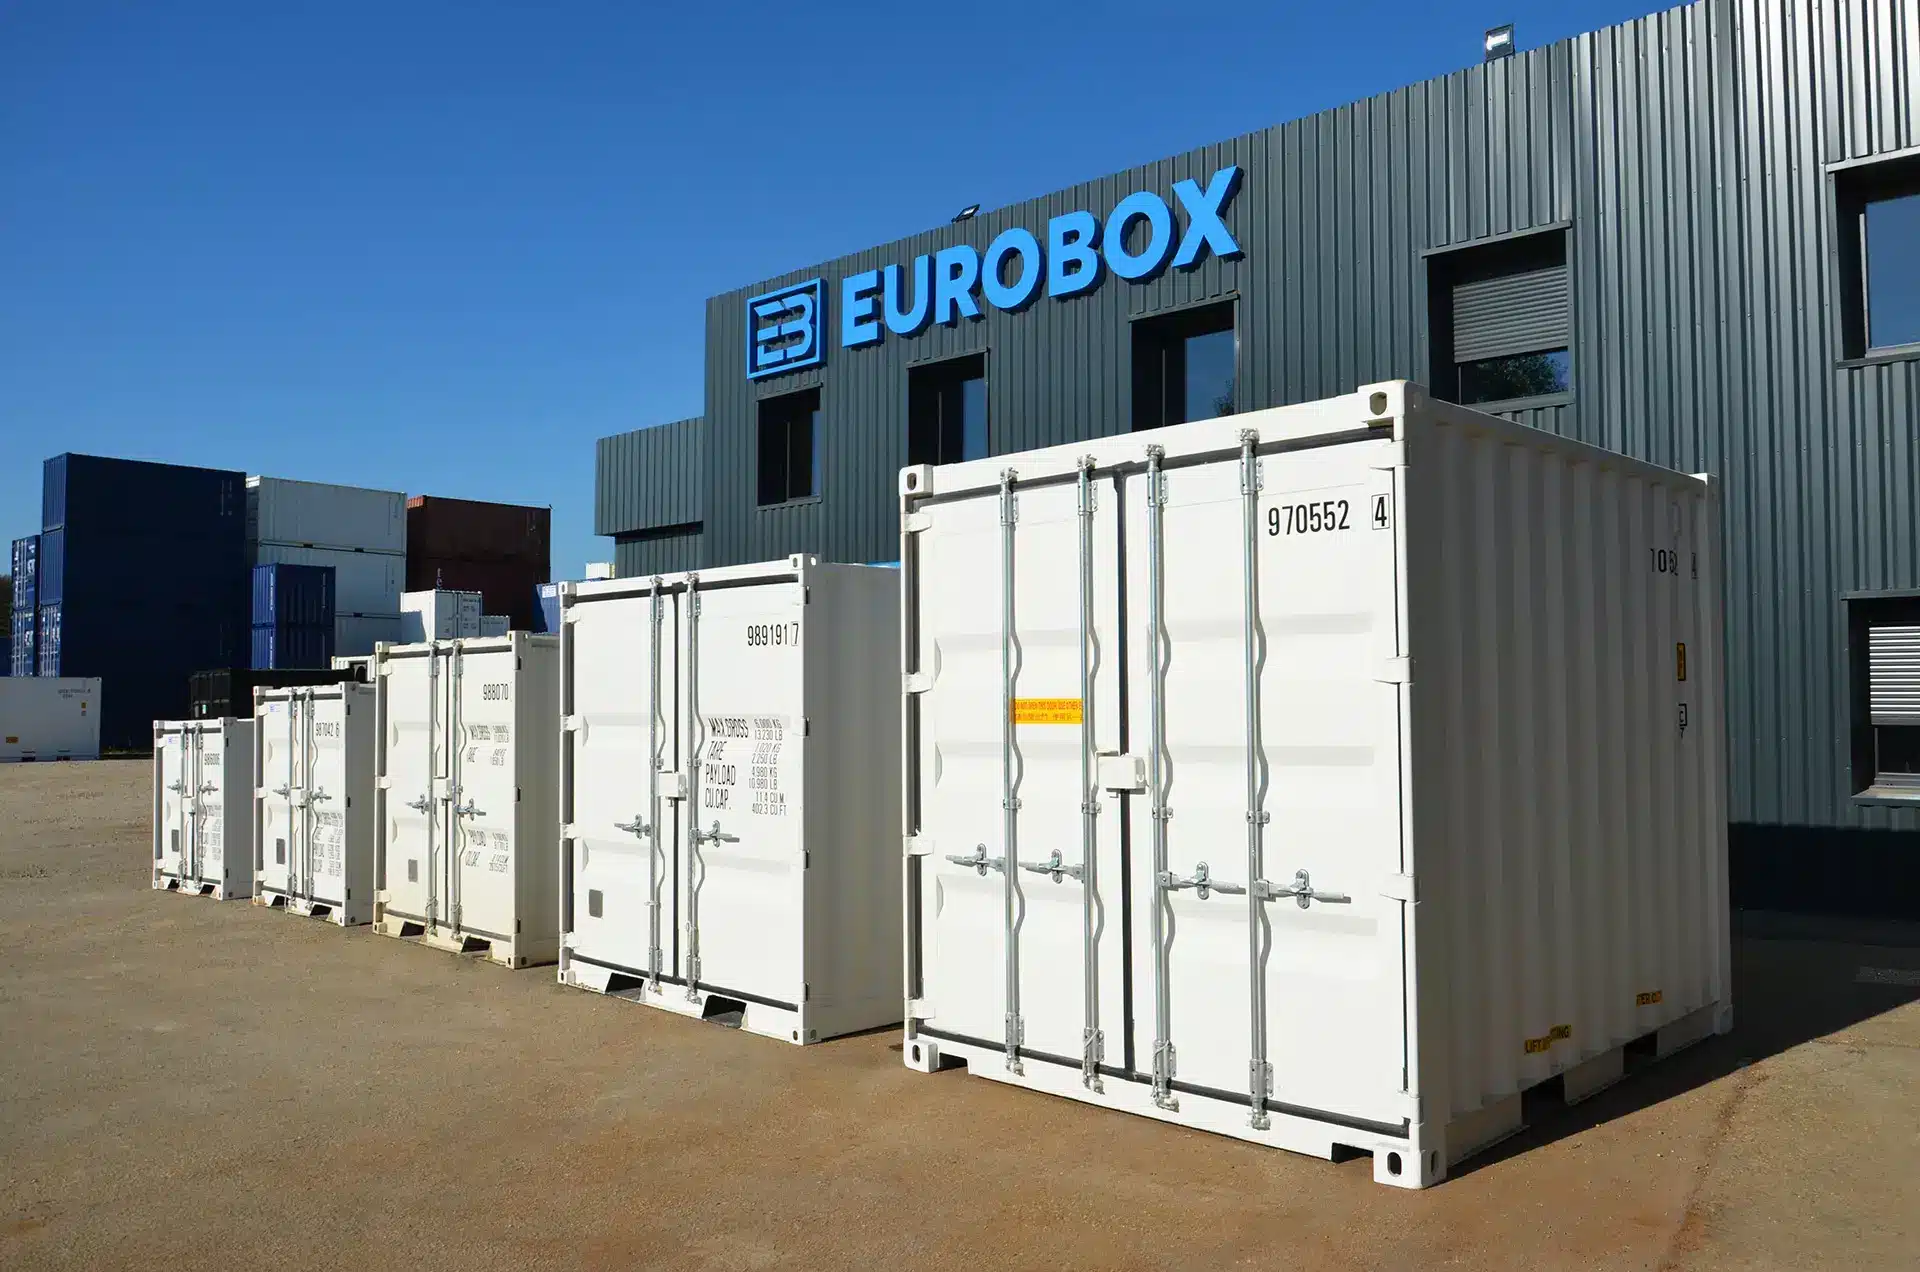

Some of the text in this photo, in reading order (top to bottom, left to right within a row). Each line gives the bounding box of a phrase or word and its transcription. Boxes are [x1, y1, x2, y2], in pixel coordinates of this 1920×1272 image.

[842, 165, 1246, 349] EUROBOX
[1268, 496, 1388, 537] 970552 4
[747, 624, 788, 646] 989191
[483, 683, 509, 701] 988070
[775, 729, 783, 741] LB
[707, 741, 727, 761] TARE
[769, 753, 778, 765] LB
[706, 763, 736, 786] PAYLOAD
[770, 778, 778, 790] LB
